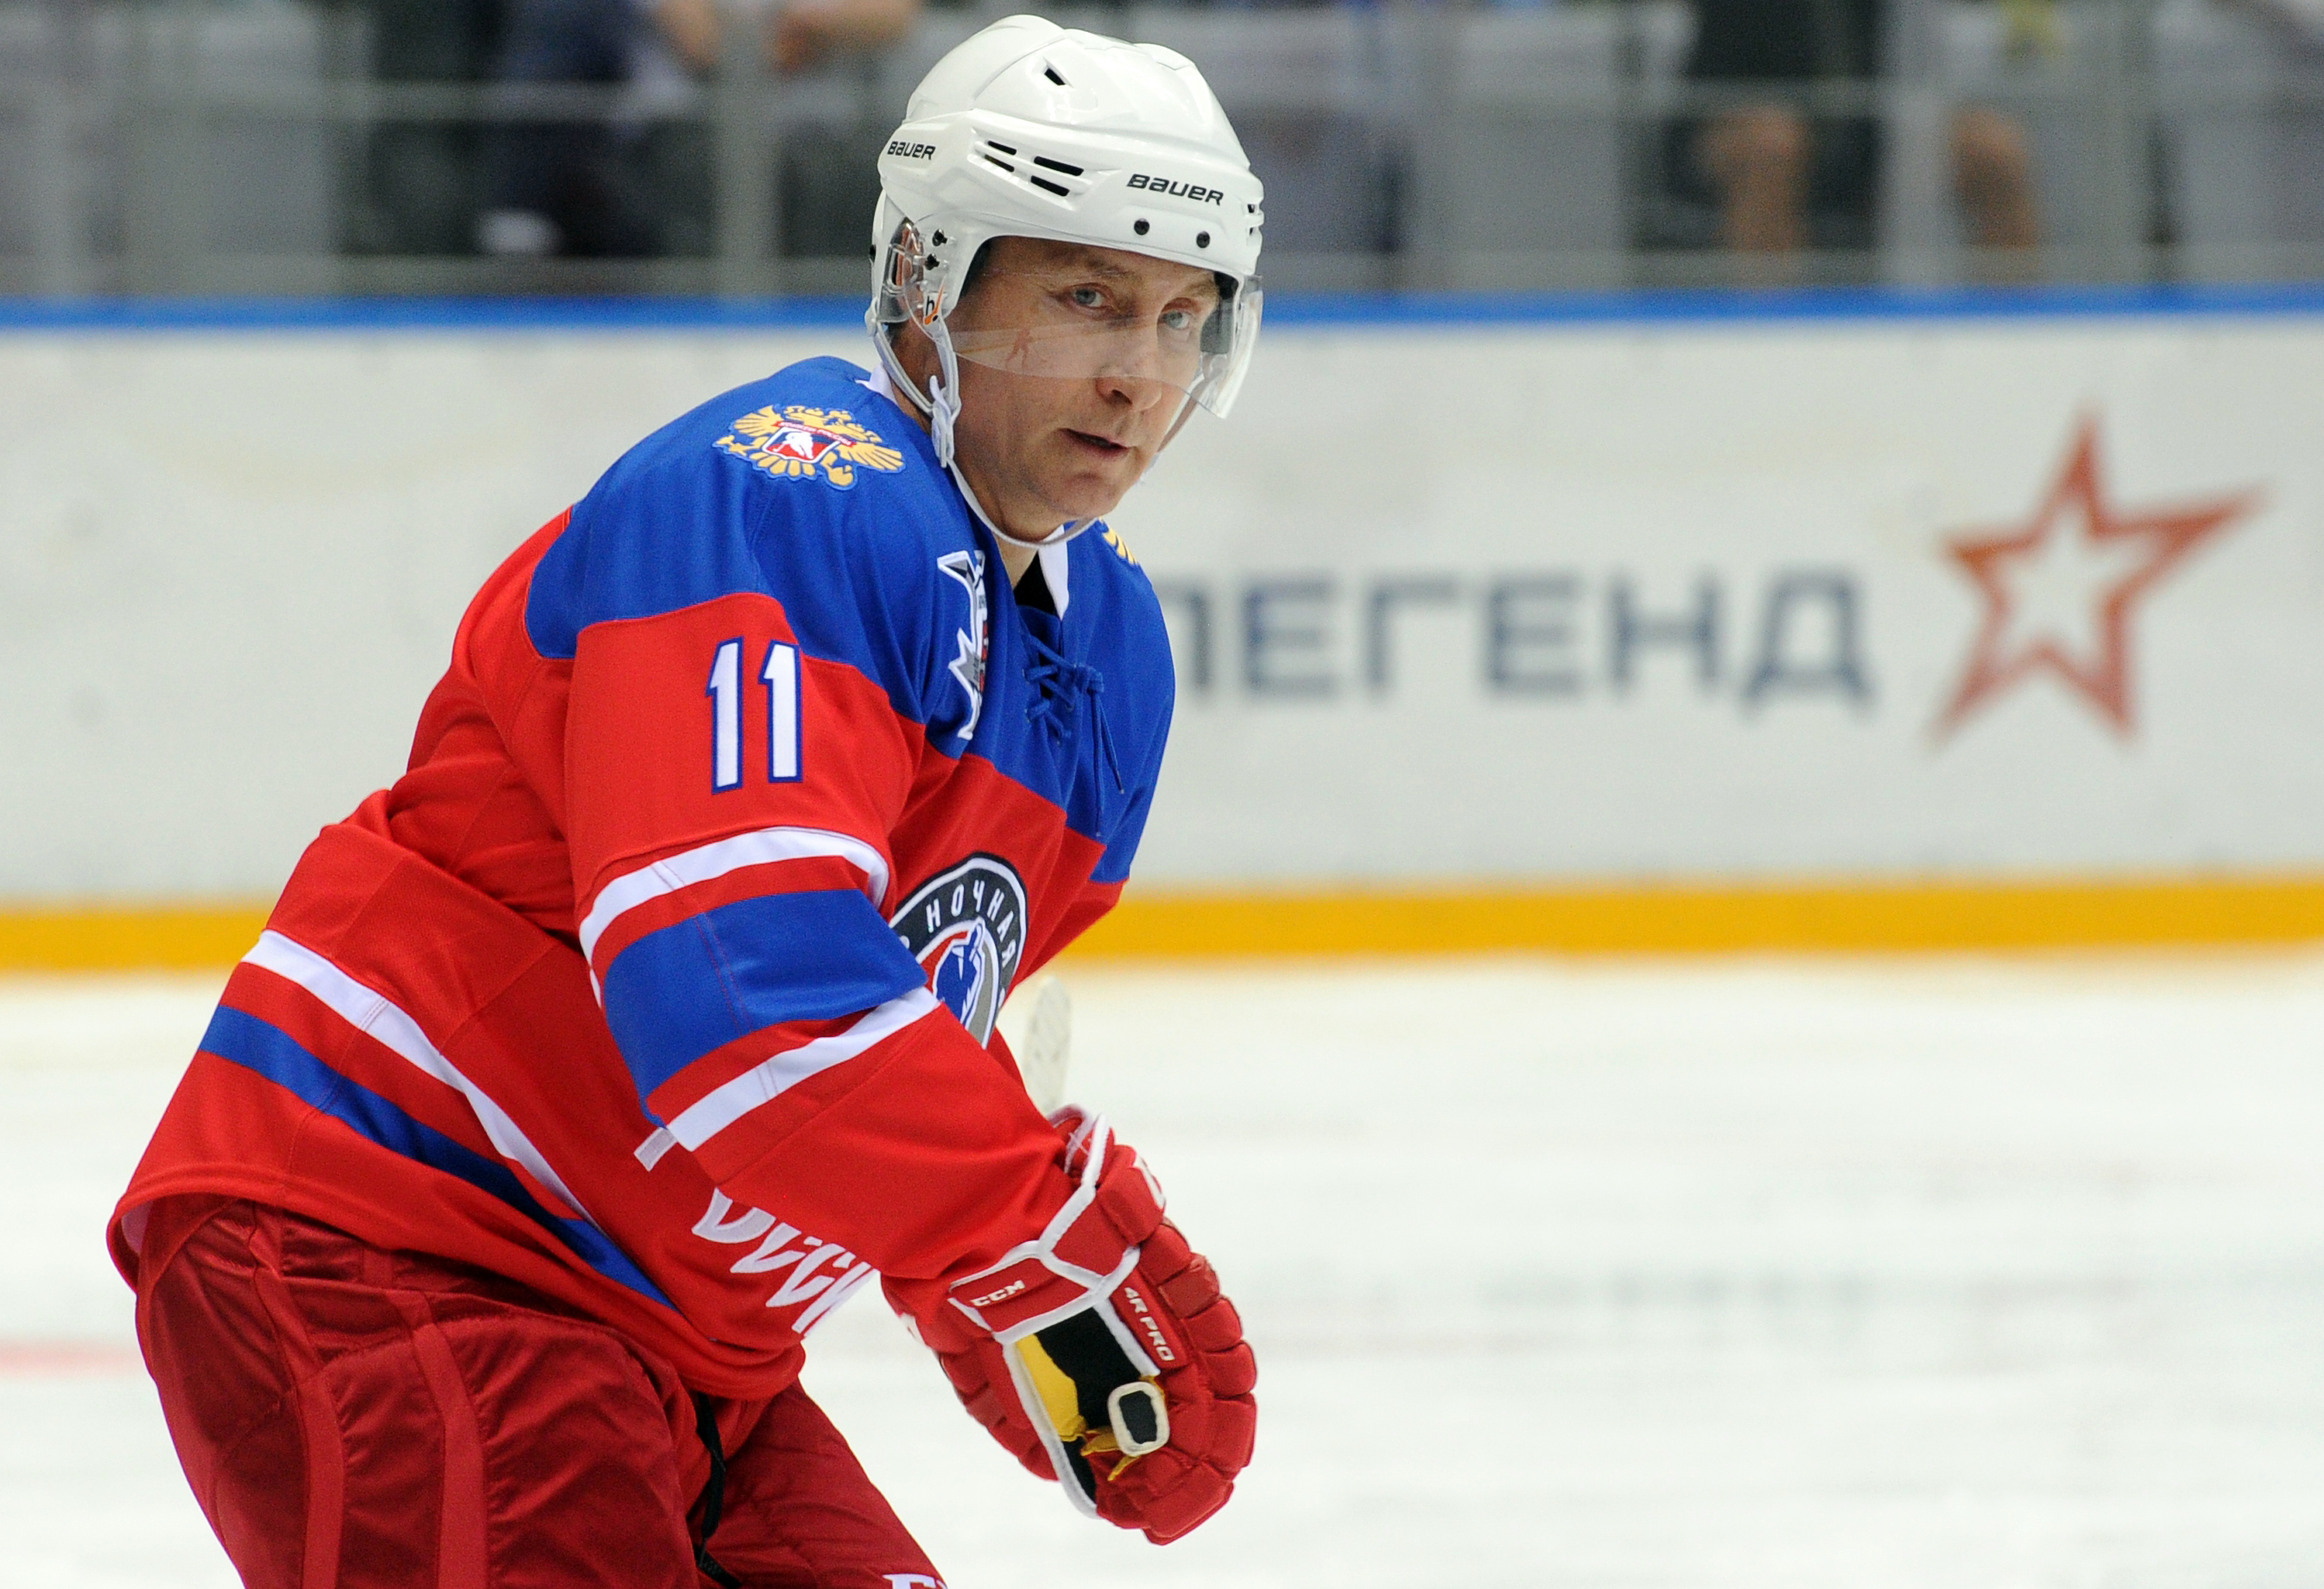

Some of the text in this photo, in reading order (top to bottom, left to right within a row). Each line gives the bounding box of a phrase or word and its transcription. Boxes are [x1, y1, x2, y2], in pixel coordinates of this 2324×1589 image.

[706, 636, 804, 794] 11
[926, 879, 1016, 968] НОЧНАЯ
[970, 1280, 1026, 1307] CCM
[1124, 1287, 1175, 1361] 4R PRO
